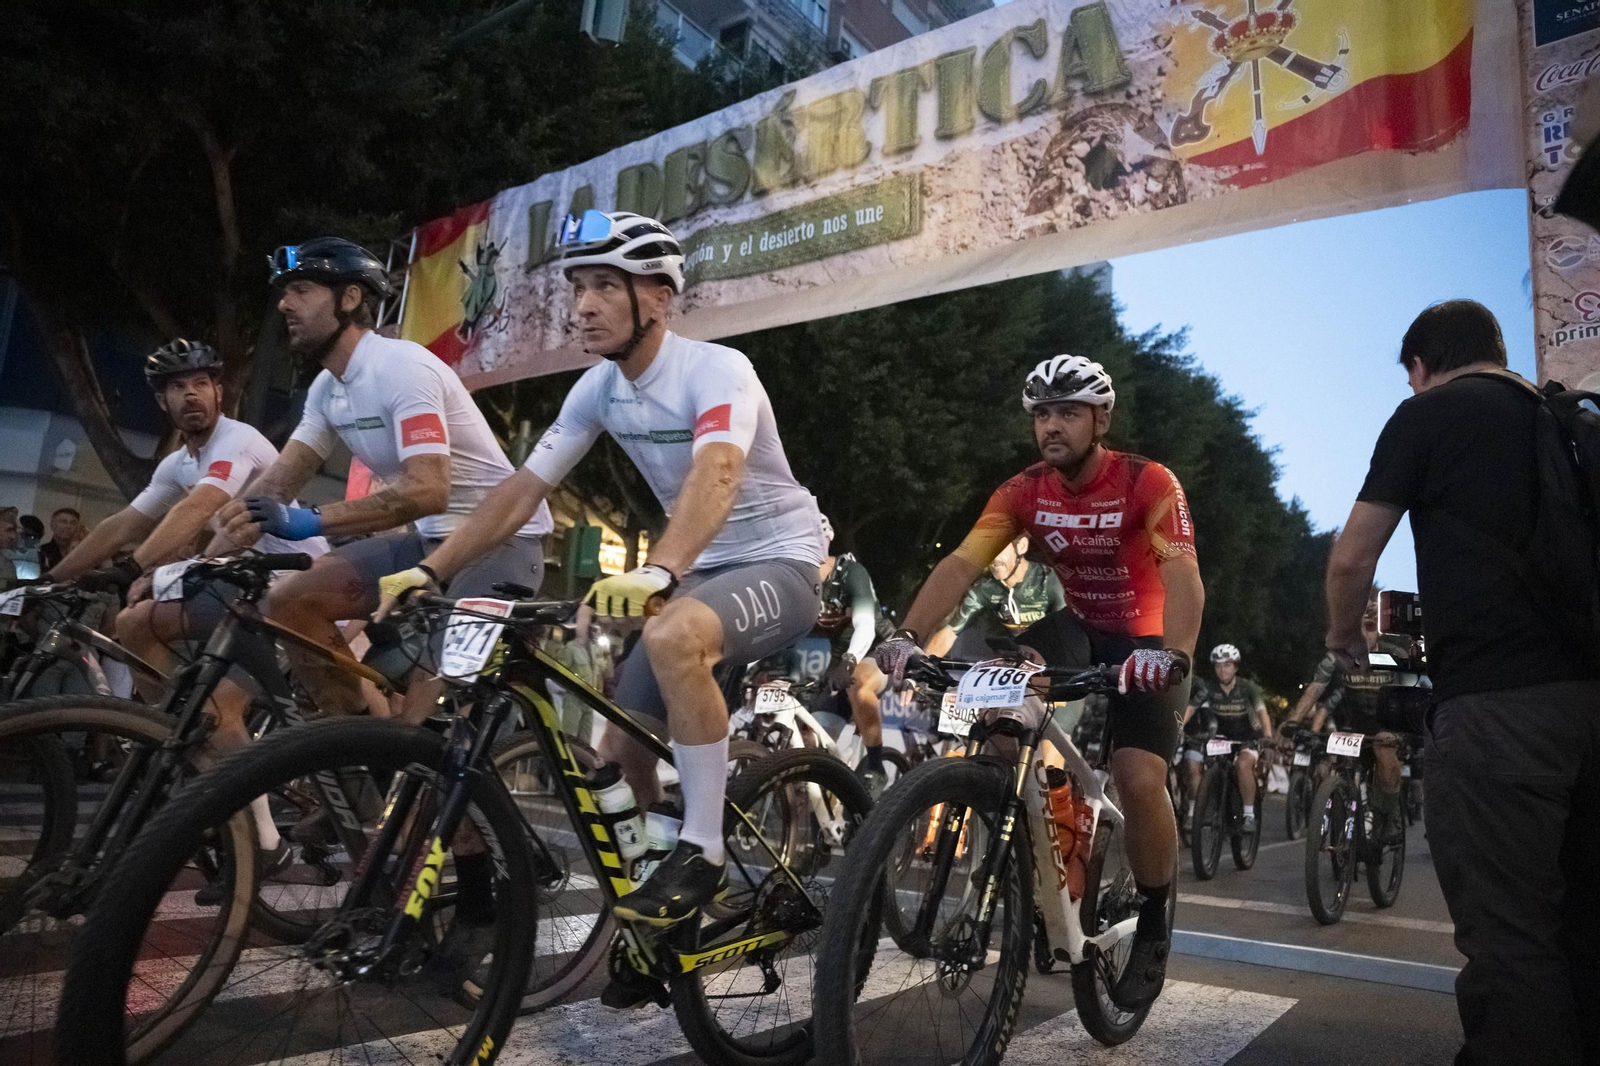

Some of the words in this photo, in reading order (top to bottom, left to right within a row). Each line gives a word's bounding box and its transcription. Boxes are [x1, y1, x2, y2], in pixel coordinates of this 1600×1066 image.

[617, 2, 1132, 226] DESÉRTICA
[723, 244, 733, 264] y
[740, 234, 753, 257] el
[759, 222, 815, 252] desierto
[822, 215, 848, 235] nos
[855, 203, 885, 227] une
[731, 580, 781, 632] JAO
[1066, 587, 1135, 600] Castrucon
[973, 668, 1029, 688] 7186
[762, 689, 787, 703] 5795
[975, 693, 1007, 703] cajamar
[1335, 736, 1360, 747] 7162
[404, 836, 446, 921] FOX
[695, 938, 767, 971] SCOTT
